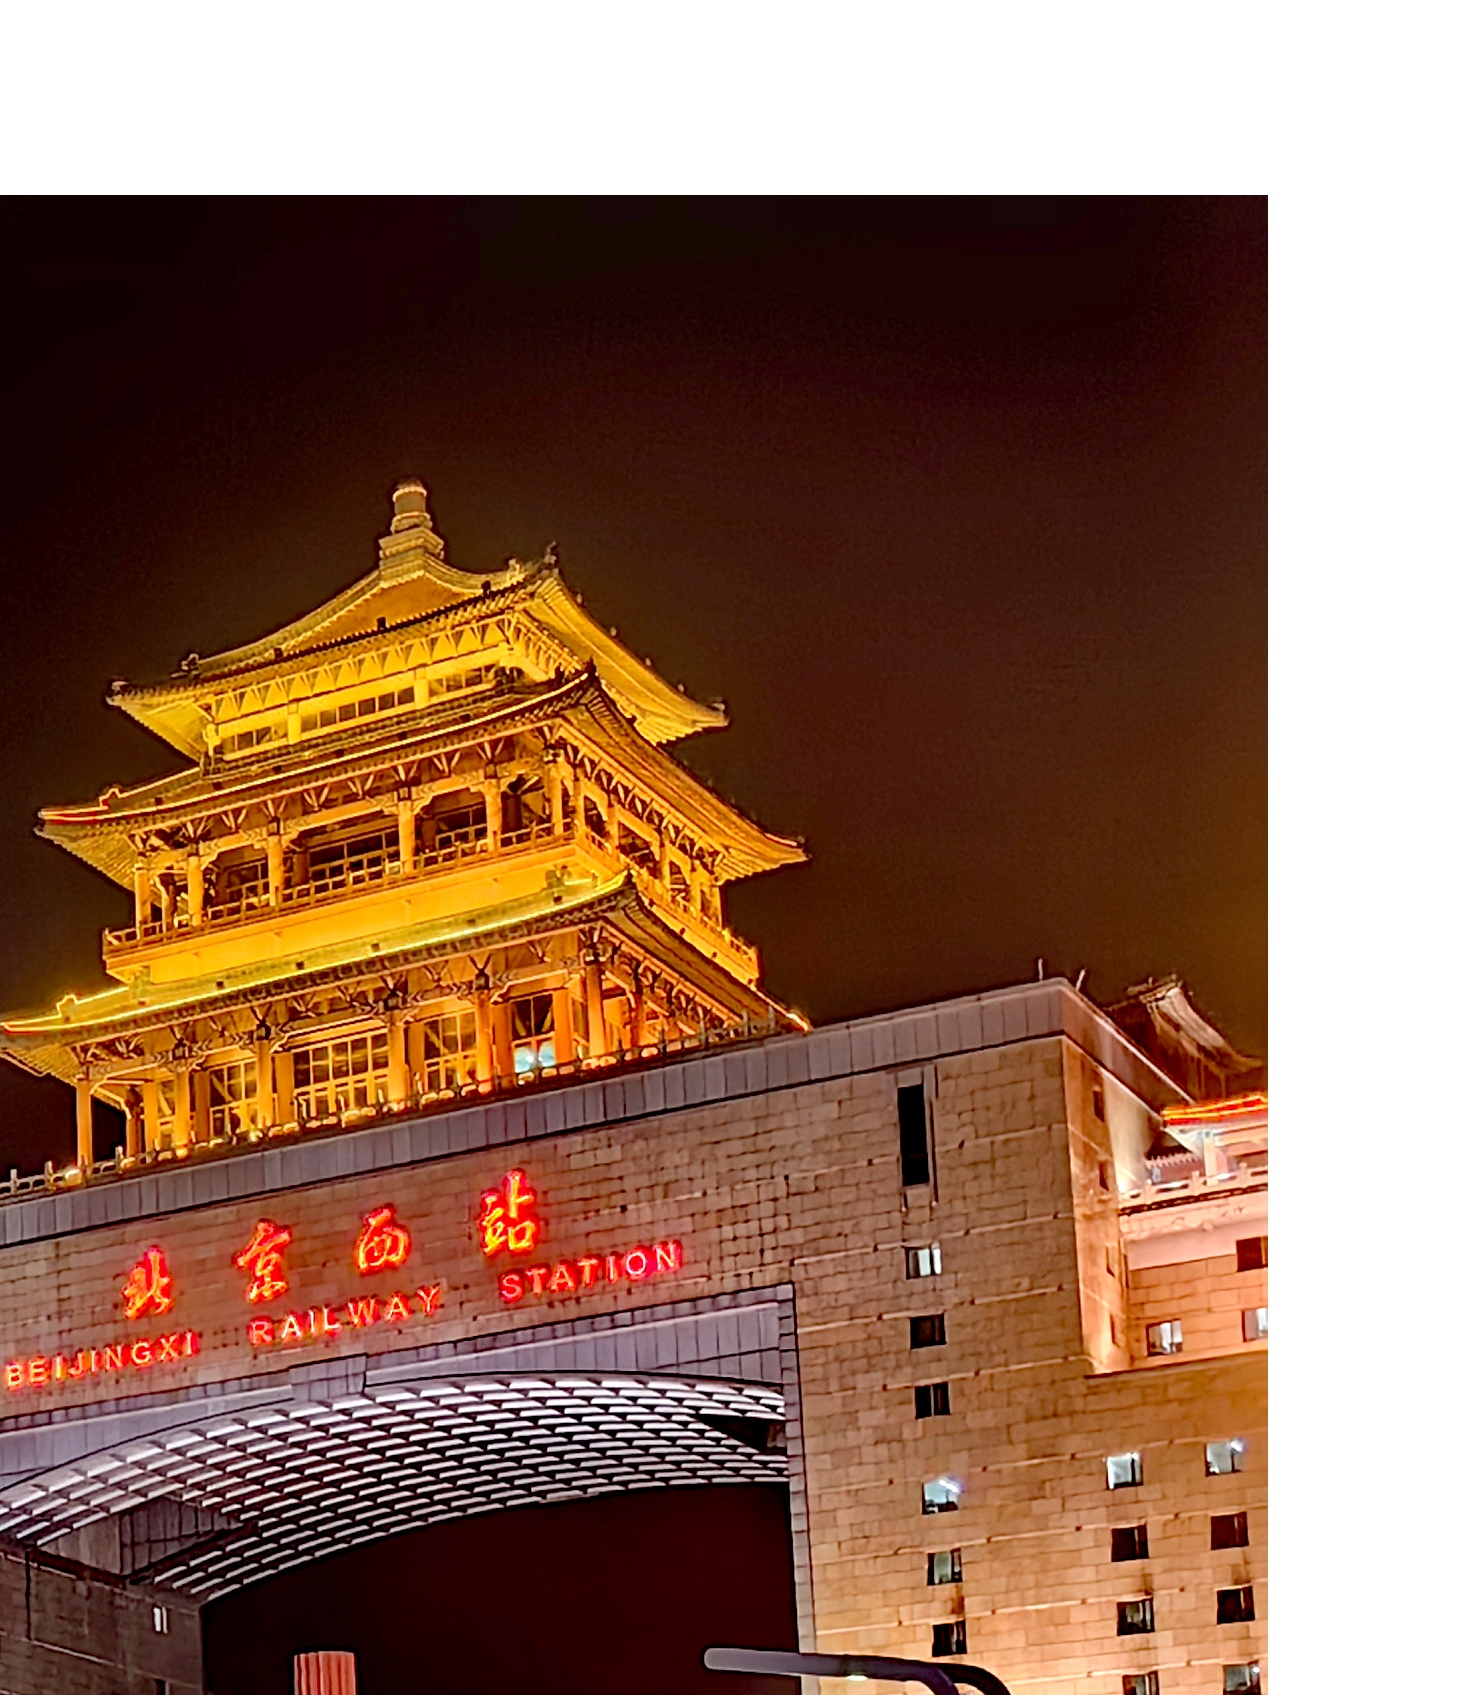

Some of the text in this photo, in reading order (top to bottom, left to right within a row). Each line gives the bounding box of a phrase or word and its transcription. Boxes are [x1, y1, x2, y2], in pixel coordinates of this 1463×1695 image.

[4, 1239, 684, 1390] BEIJINGXI RAILWAY STATION
[122, 1167, 541, 1320] 北京西站
